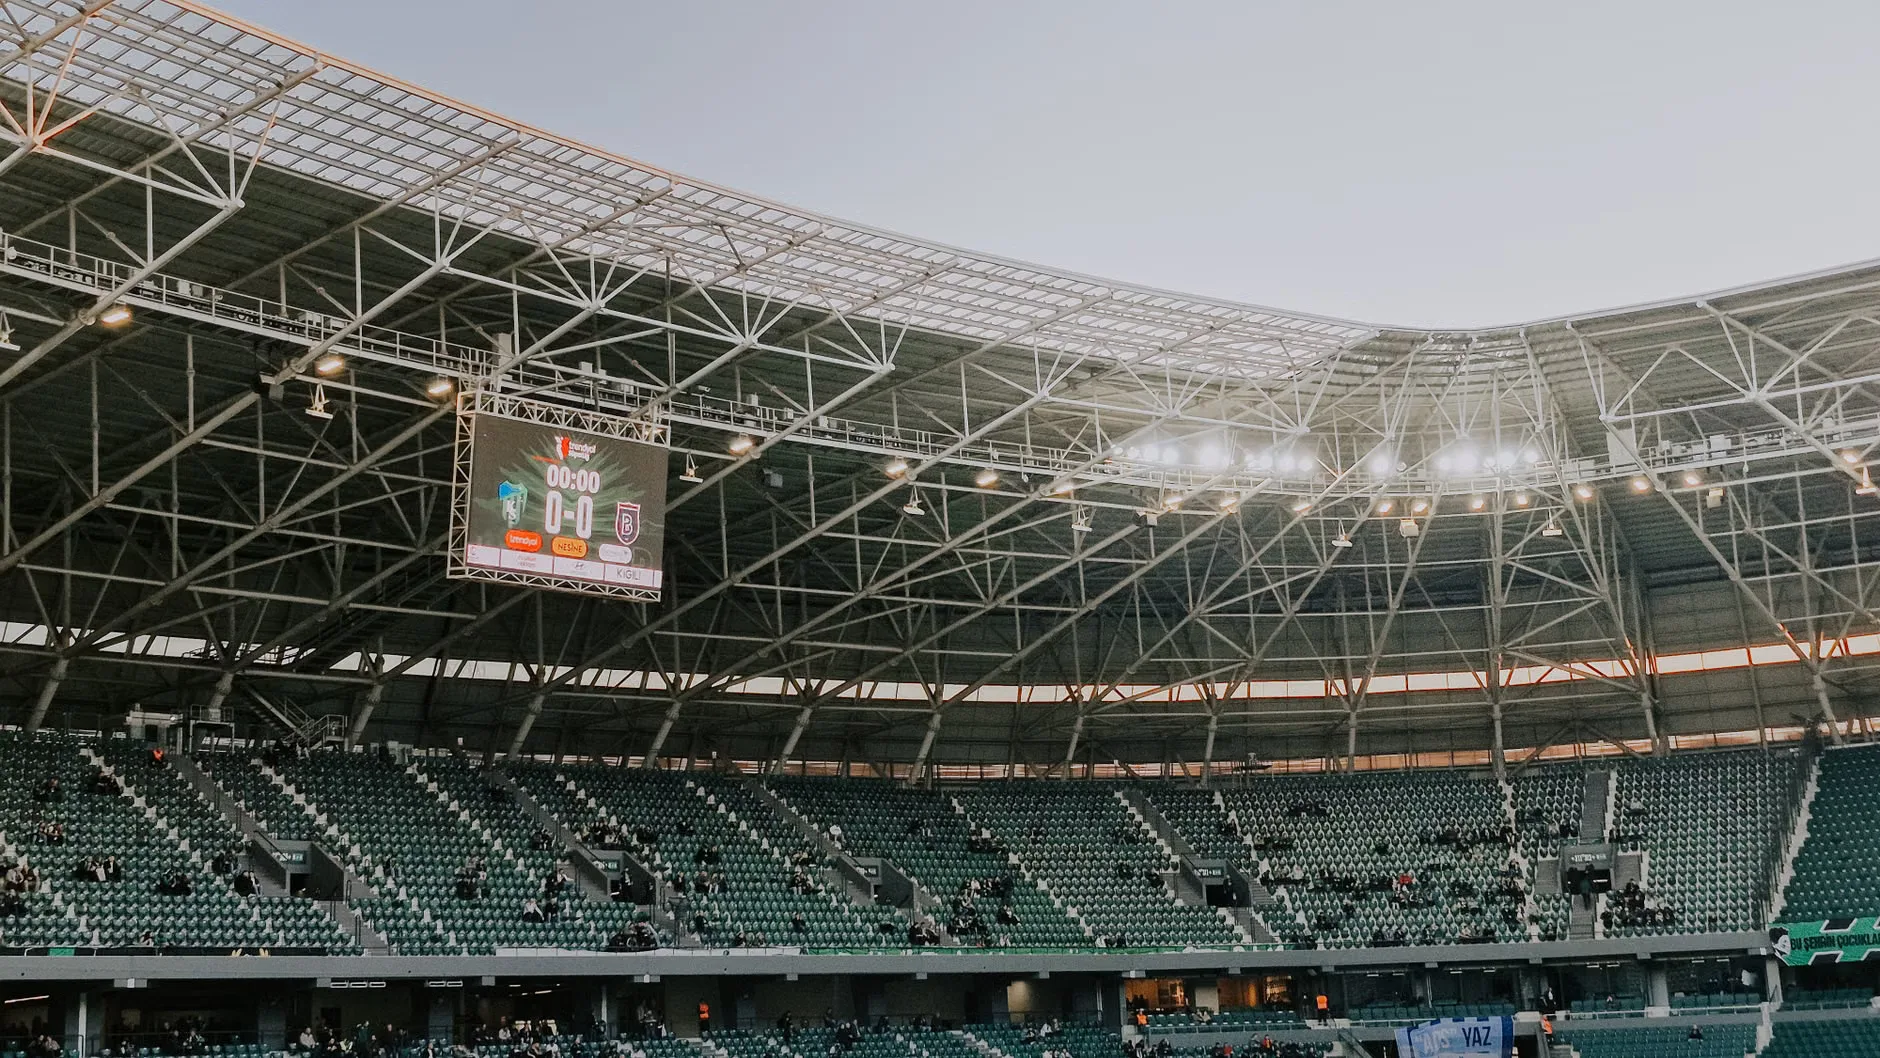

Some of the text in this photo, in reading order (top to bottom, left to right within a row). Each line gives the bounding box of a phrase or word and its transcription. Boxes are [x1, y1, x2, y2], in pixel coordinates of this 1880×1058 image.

[547, 464, 600, 493] 00:00
[545, 491, 593, 539] 0-0
[510, 534, 537, 547] trendyol
[1791, 938, 1802, 950] BU
[1462, 1026, 1492, 1047] YAZ
